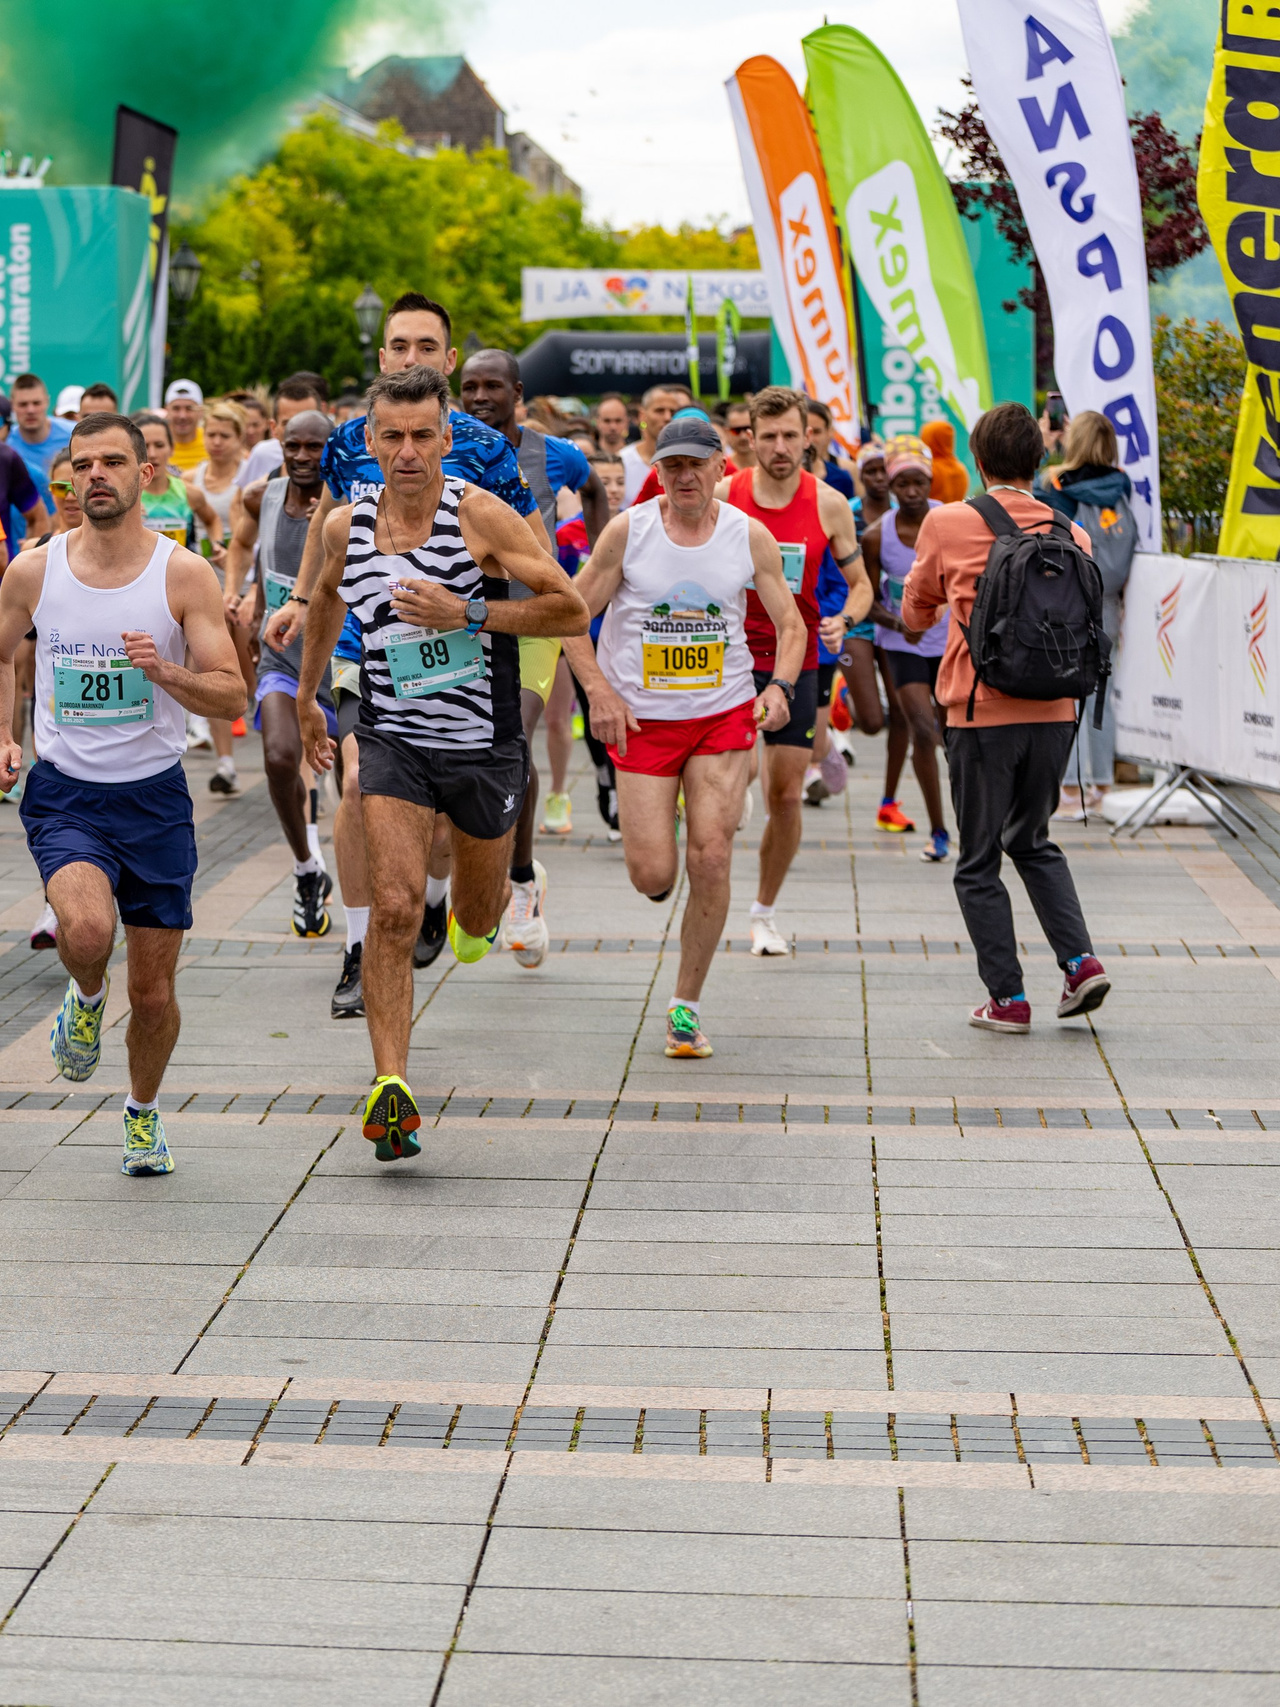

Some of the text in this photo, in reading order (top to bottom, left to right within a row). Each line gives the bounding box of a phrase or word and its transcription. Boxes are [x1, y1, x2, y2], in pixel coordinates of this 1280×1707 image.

[556, 279, 592, 302] JA
[662, 279, 769, 302] NEKOG
[50, 633, 60, 642] 22
[419, 638, 450, 669] 89
[661, 646, 708, 670] 1069
[81, 673, 124, 701] 281
